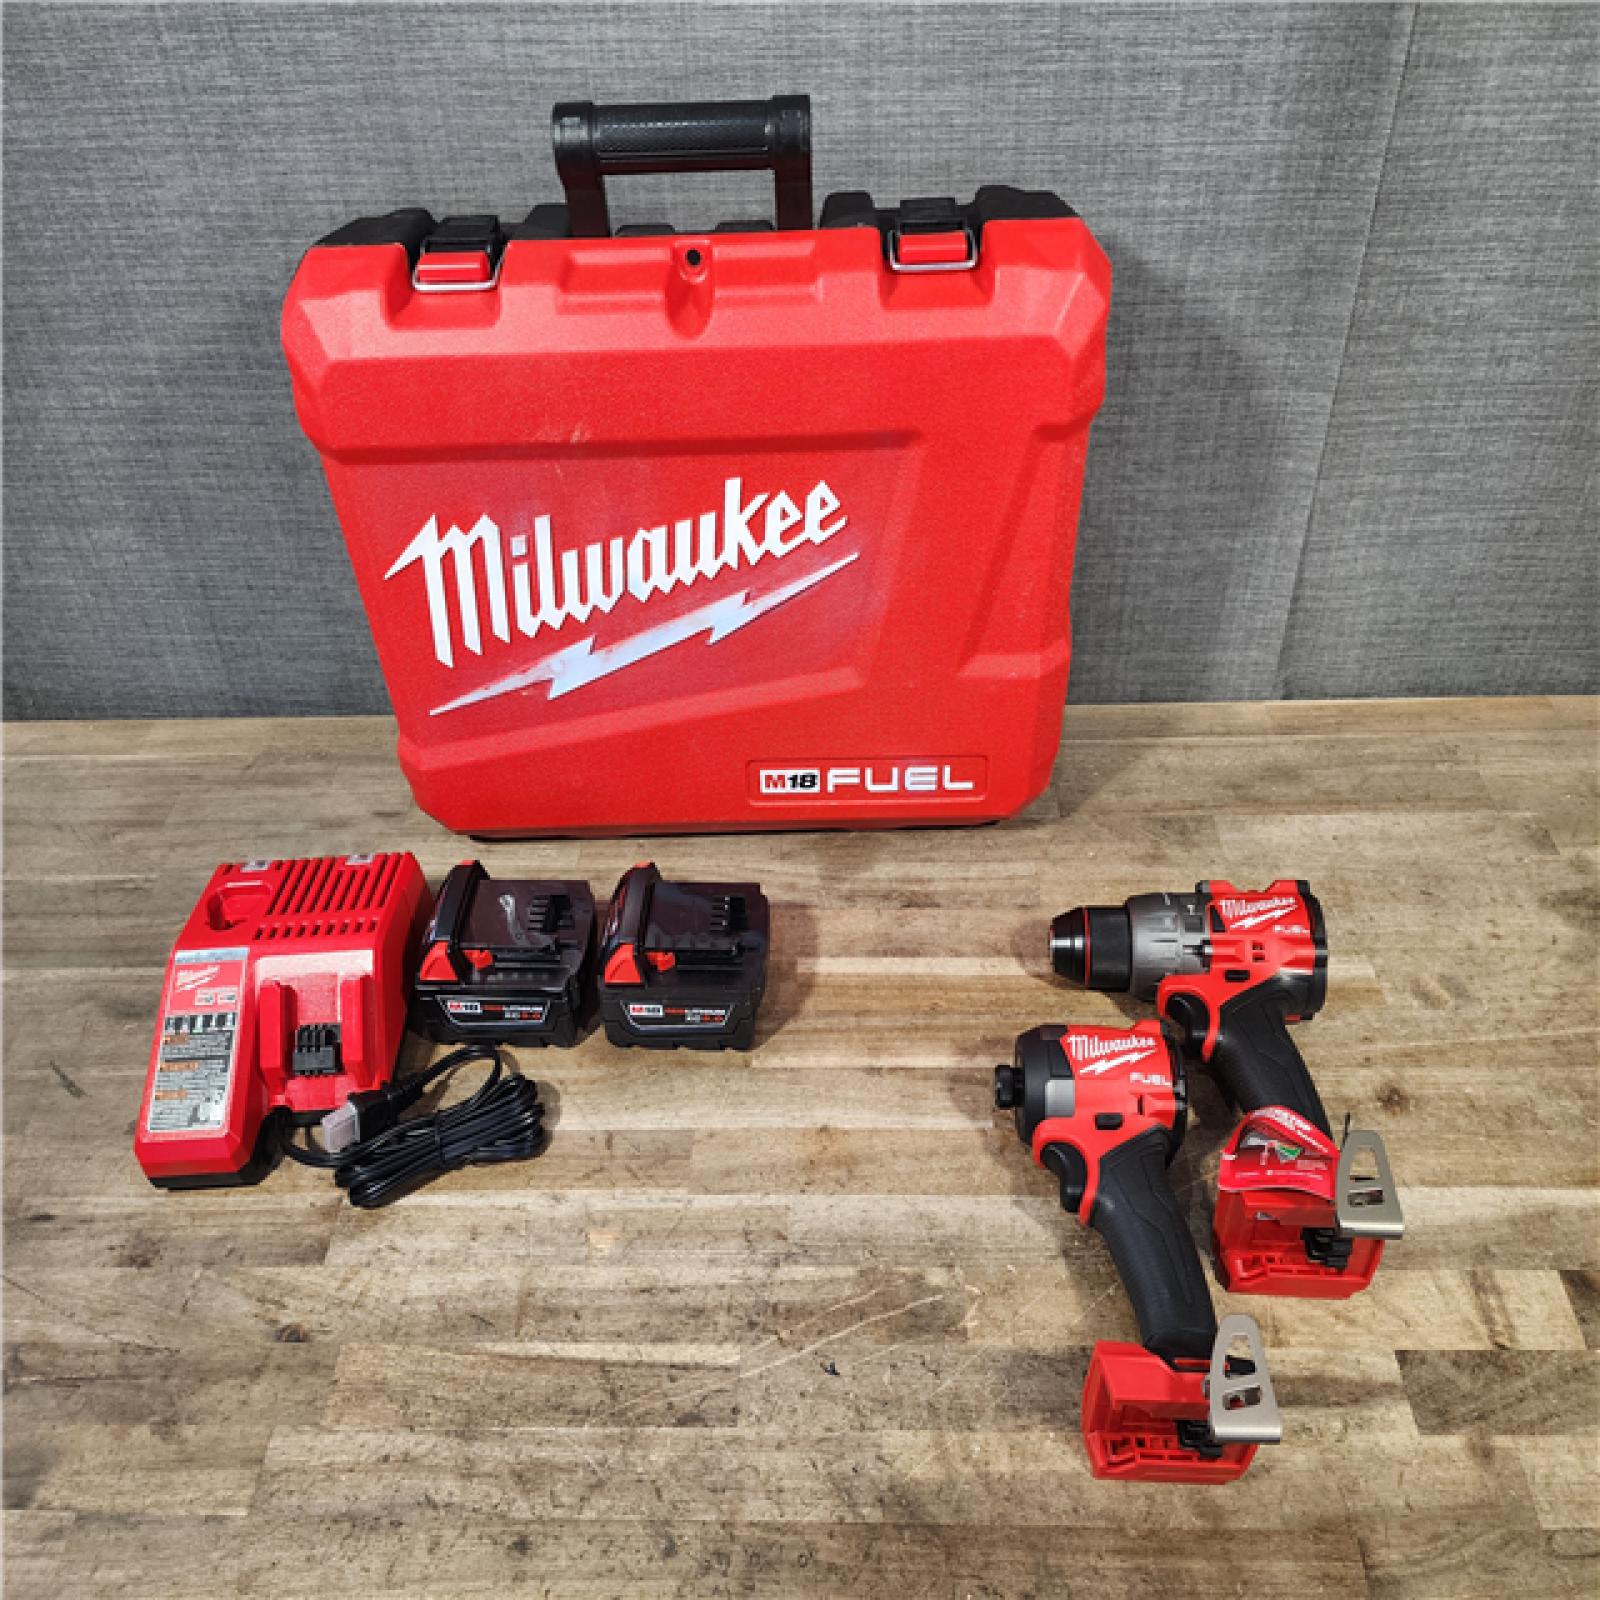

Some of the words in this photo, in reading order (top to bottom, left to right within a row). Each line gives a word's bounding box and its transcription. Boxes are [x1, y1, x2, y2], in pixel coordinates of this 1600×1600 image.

[384, 476, 849, 668] Milwaukee
[764, 773, 818, 790] M18
[827, 764, 974, 793] FUEL
[1219, 896, 1296, 919] Milwaukee
[1067, 1034, 1156, 1061] Milwaukee
[1129, 1071, 1172, 1087] FUEL
